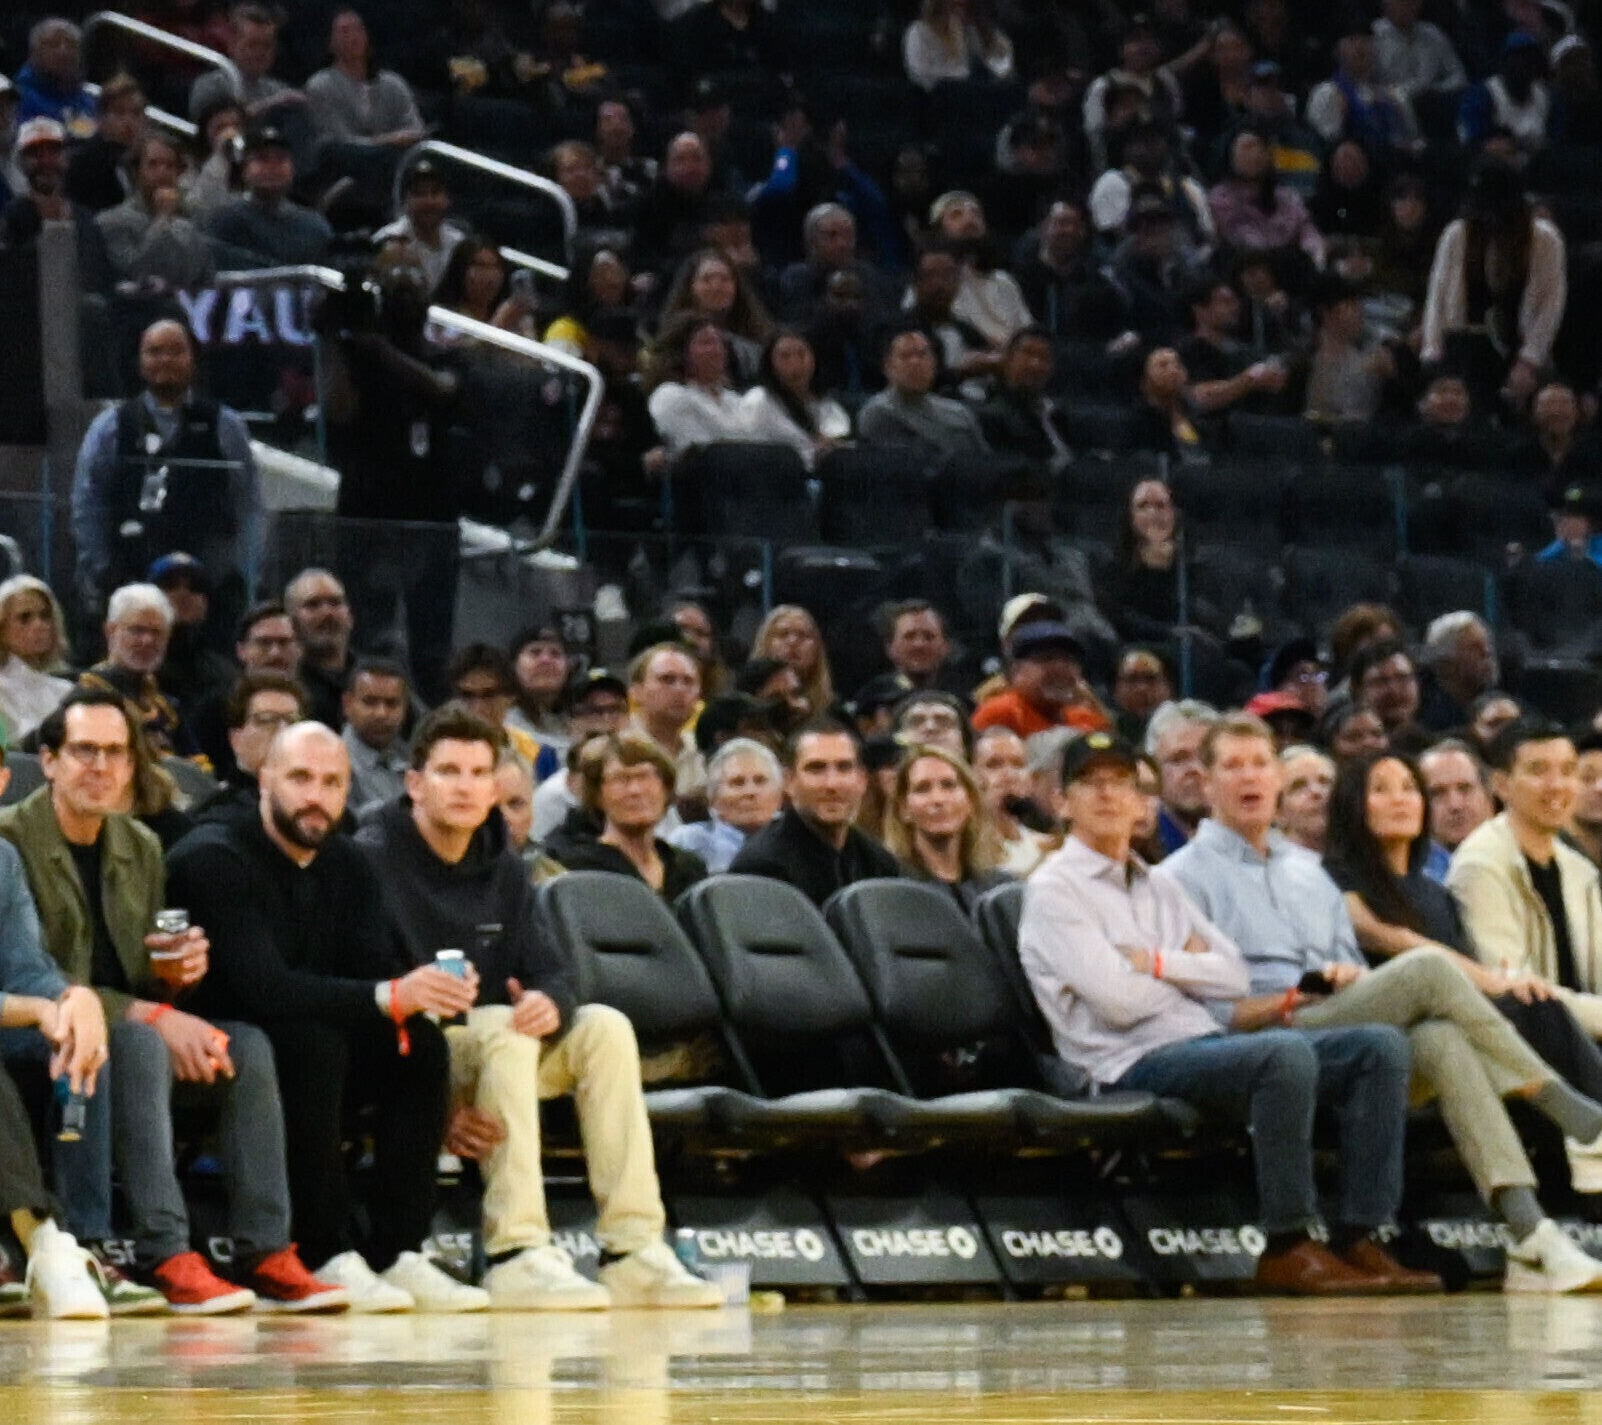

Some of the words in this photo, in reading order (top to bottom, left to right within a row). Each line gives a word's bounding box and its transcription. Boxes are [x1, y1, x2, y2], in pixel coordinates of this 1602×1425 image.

[694, 1229, 794, 1260] CHASE
[851, 1229, 947, 1258] CHASE
[1001, 1229, 1095, 1258] CHASE
[1147, 1228, 1239, 1256] CHASE
